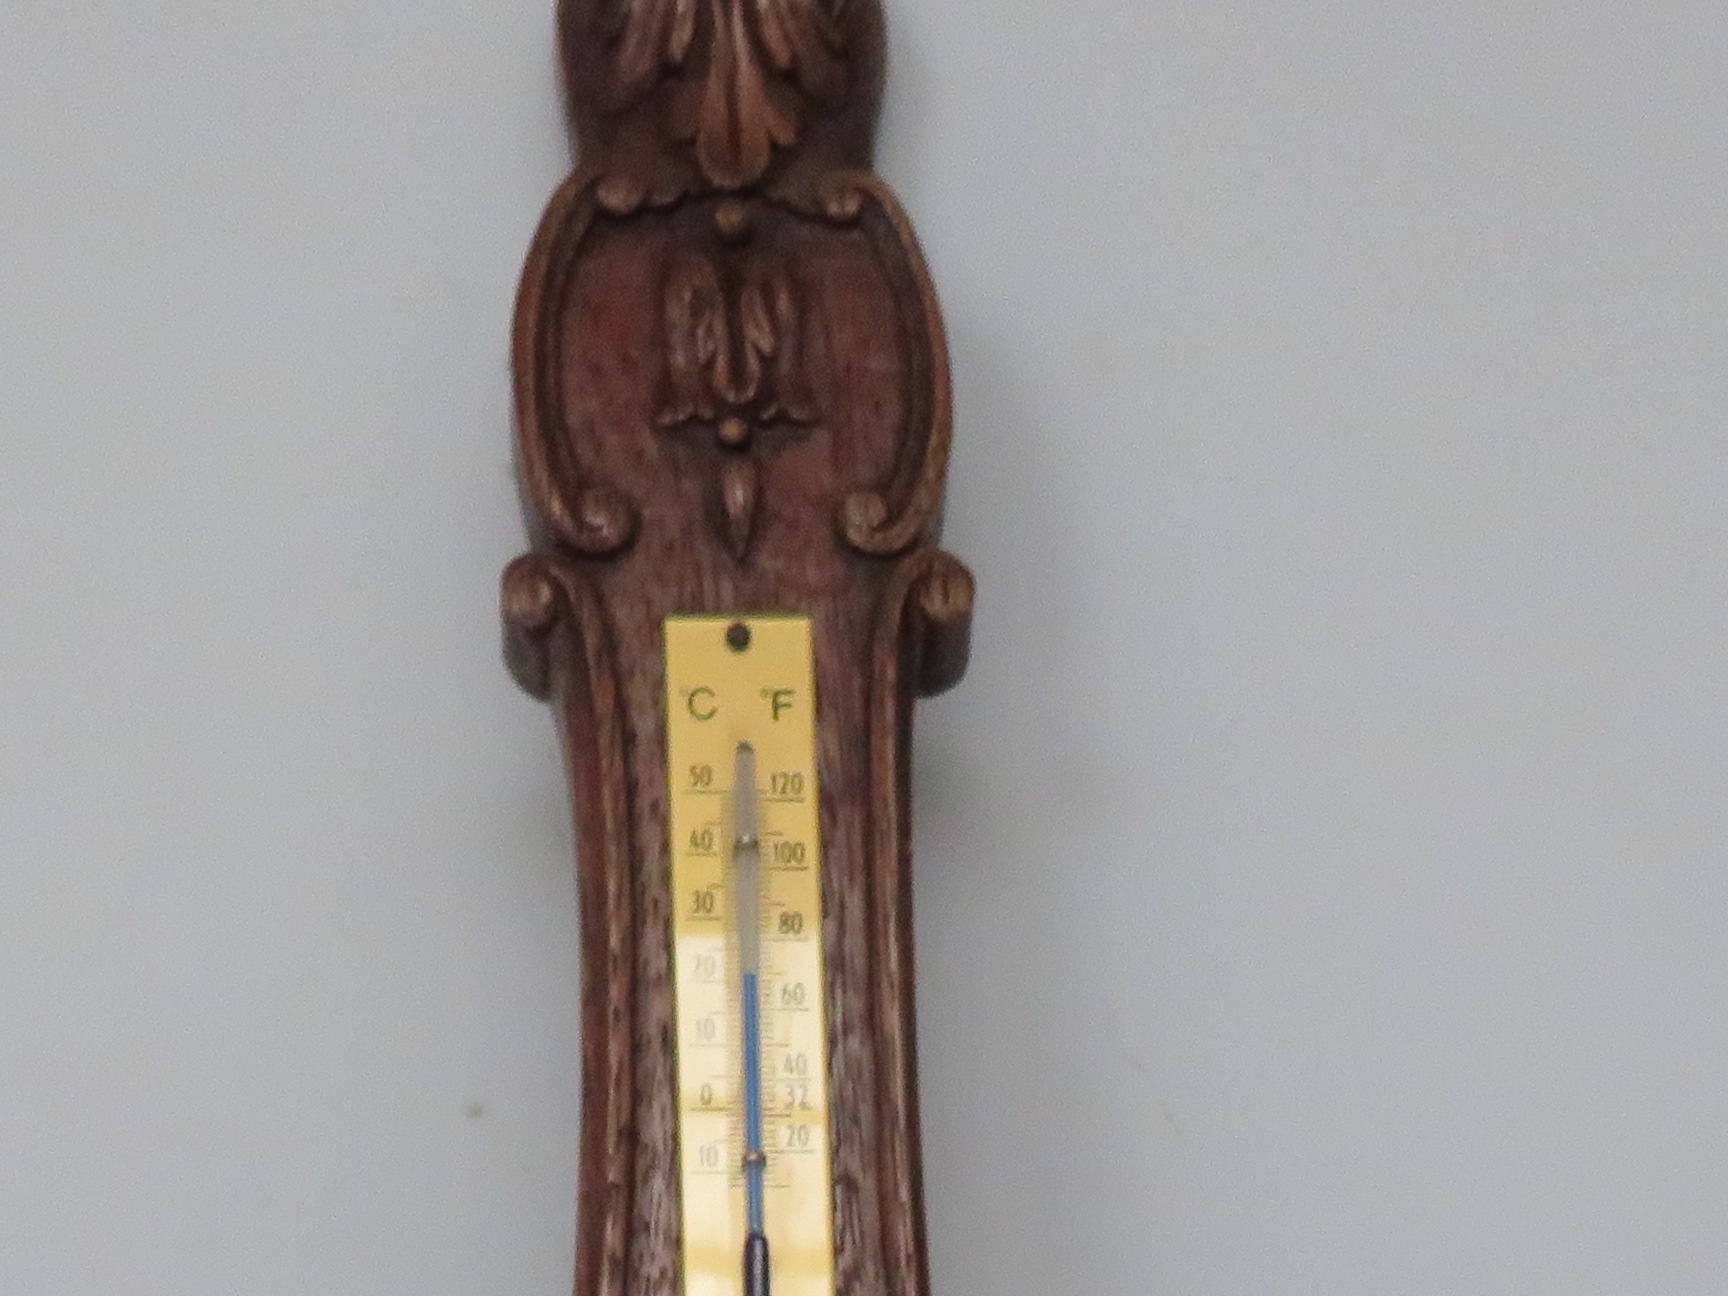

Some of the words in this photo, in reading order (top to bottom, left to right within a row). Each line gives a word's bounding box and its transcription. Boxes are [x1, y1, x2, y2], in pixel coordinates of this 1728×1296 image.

[689, 765, 713, 788] 50
[771, 771, 805, 797] 120
[688, 829, 714, 852] 40
[773, 842, 806, 866] 100
[778, 911, 803, 935] 80
[780, 981, 806, 1006] 60
[695, 1017, 717, 1040] 10
[783, 1052, 808, 1076] 40
[699, 1082, 714, 1107] 0
[785, 1124, 811, 1149] 20
